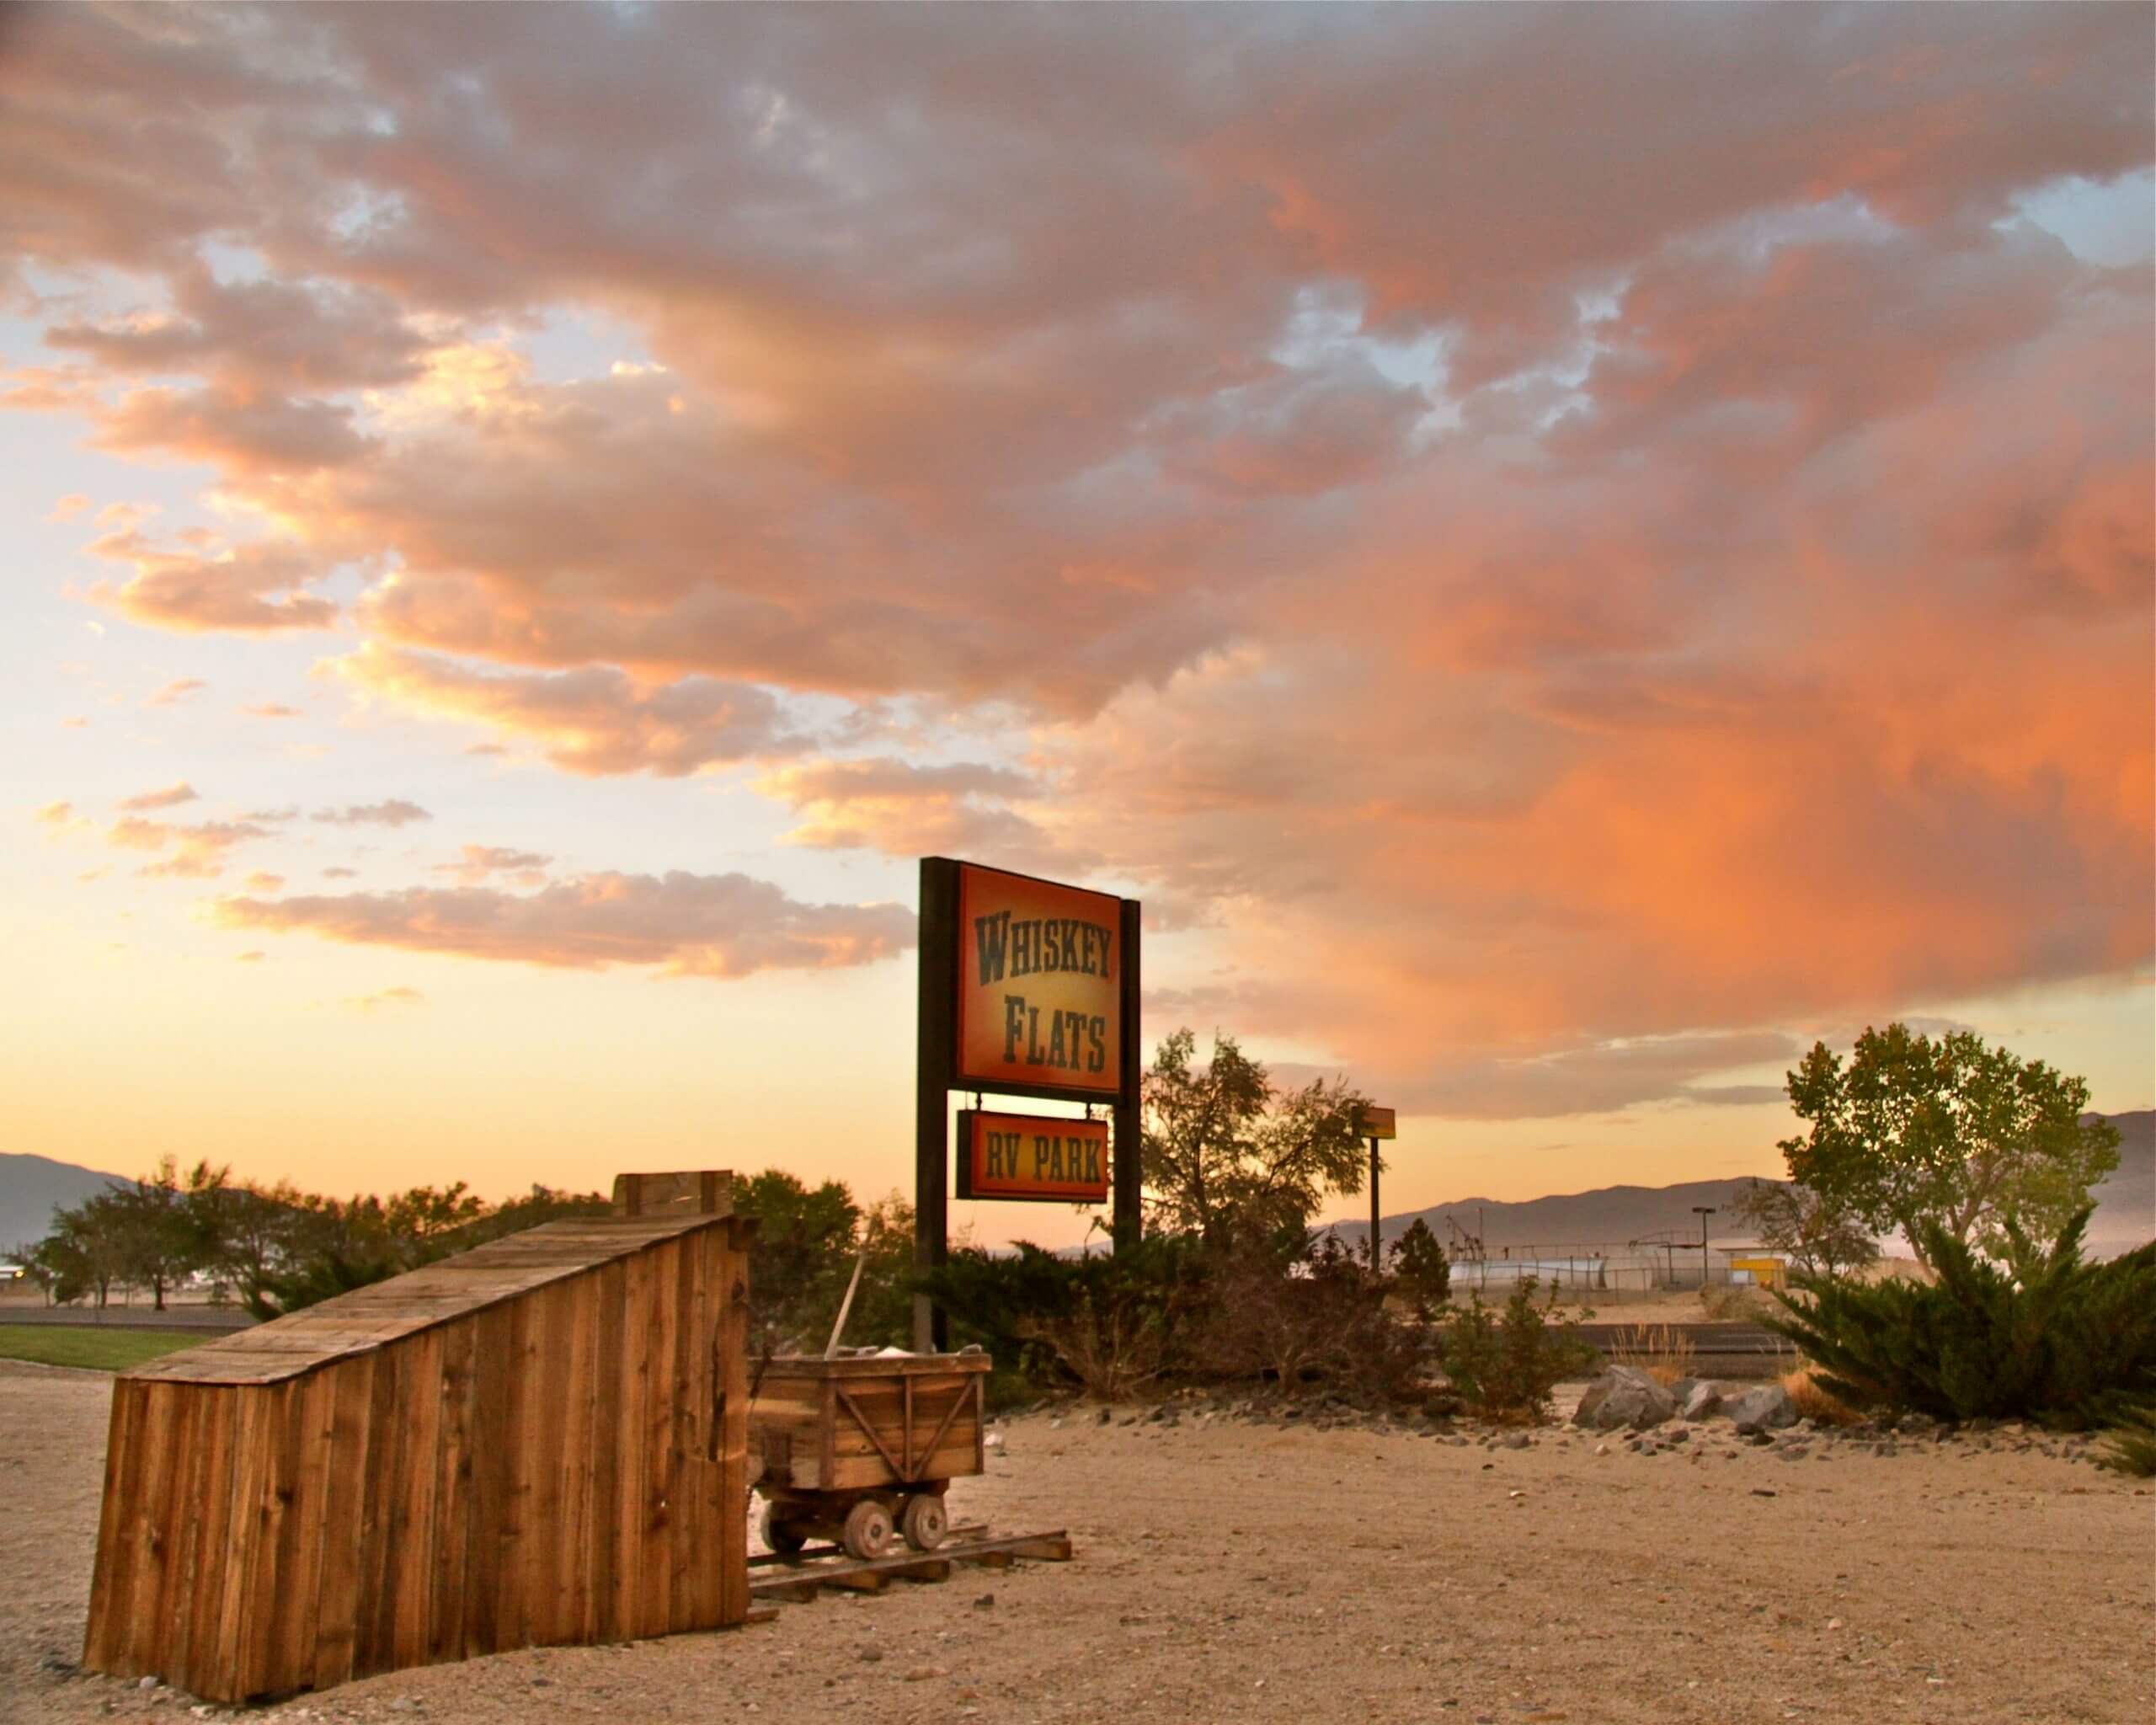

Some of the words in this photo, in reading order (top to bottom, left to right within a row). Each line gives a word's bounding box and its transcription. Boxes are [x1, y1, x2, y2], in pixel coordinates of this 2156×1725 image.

[974, 911, 1113, 986] WHISKEY
[1004, 995, 1106, 1072] FLATS
[985, 1132, 1021, 1179] RV
[1033, 1135, 1102, 1183] PARK
